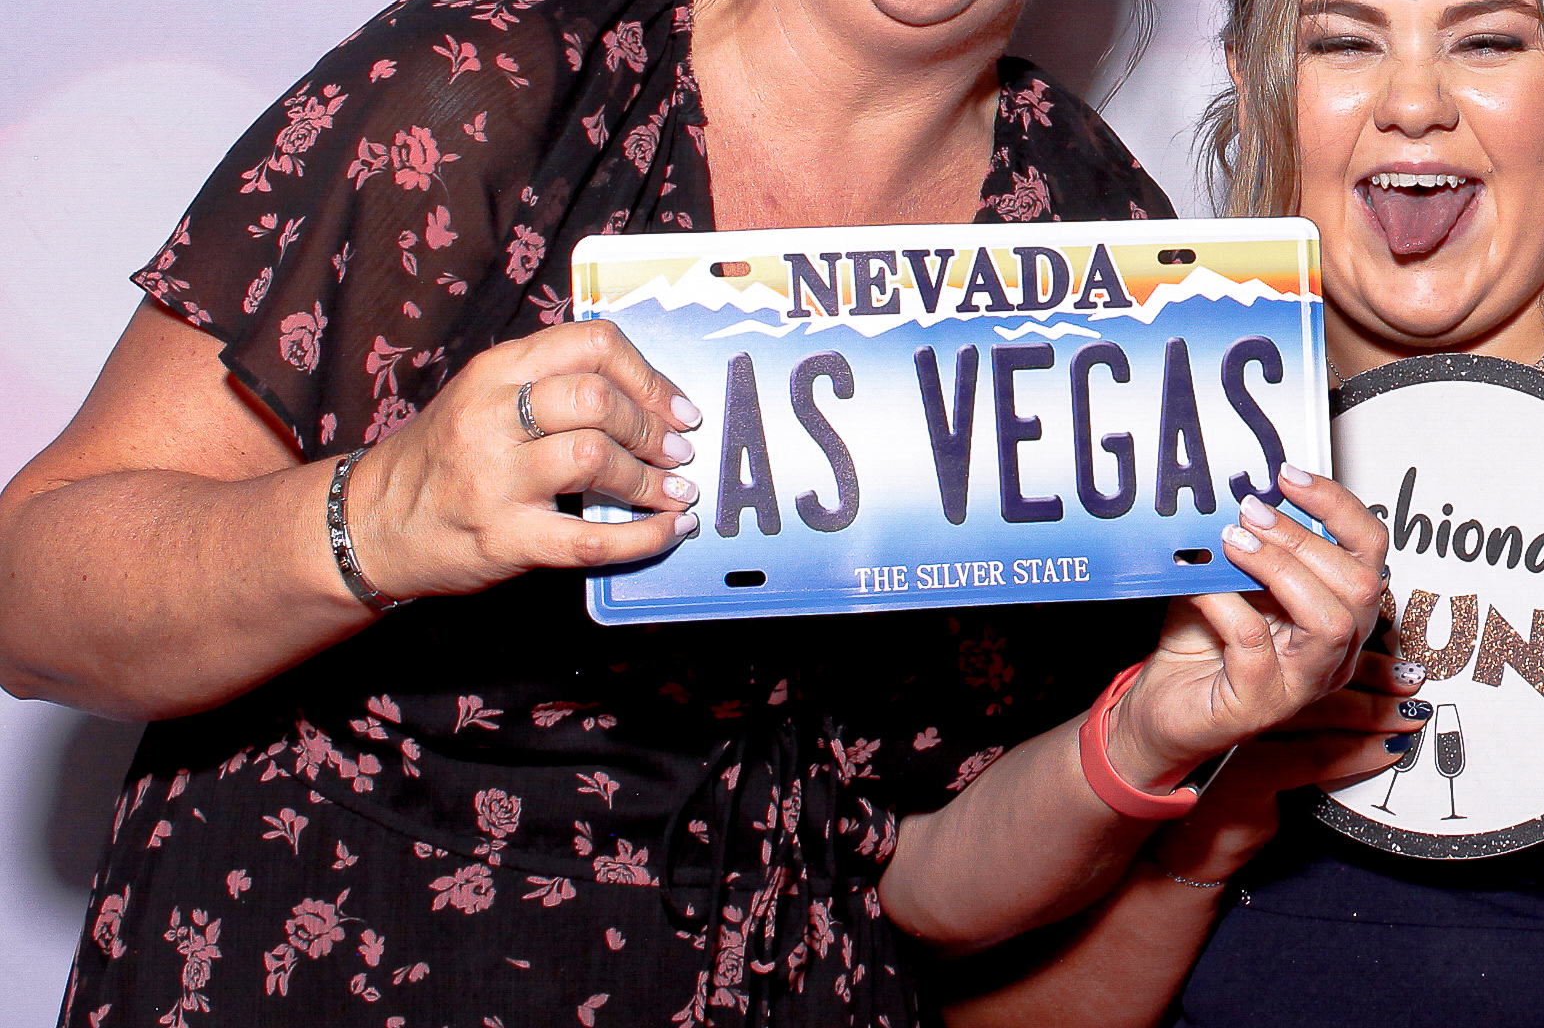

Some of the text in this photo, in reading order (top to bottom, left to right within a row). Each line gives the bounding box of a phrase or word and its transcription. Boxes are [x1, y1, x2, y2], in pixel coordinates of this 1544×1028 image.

[783, 243, 1133, 318] NEVADA
[633, 335, 1285, 538] AS VEGAS
[854, 556, 1090, 593] THE SILVER STATE
